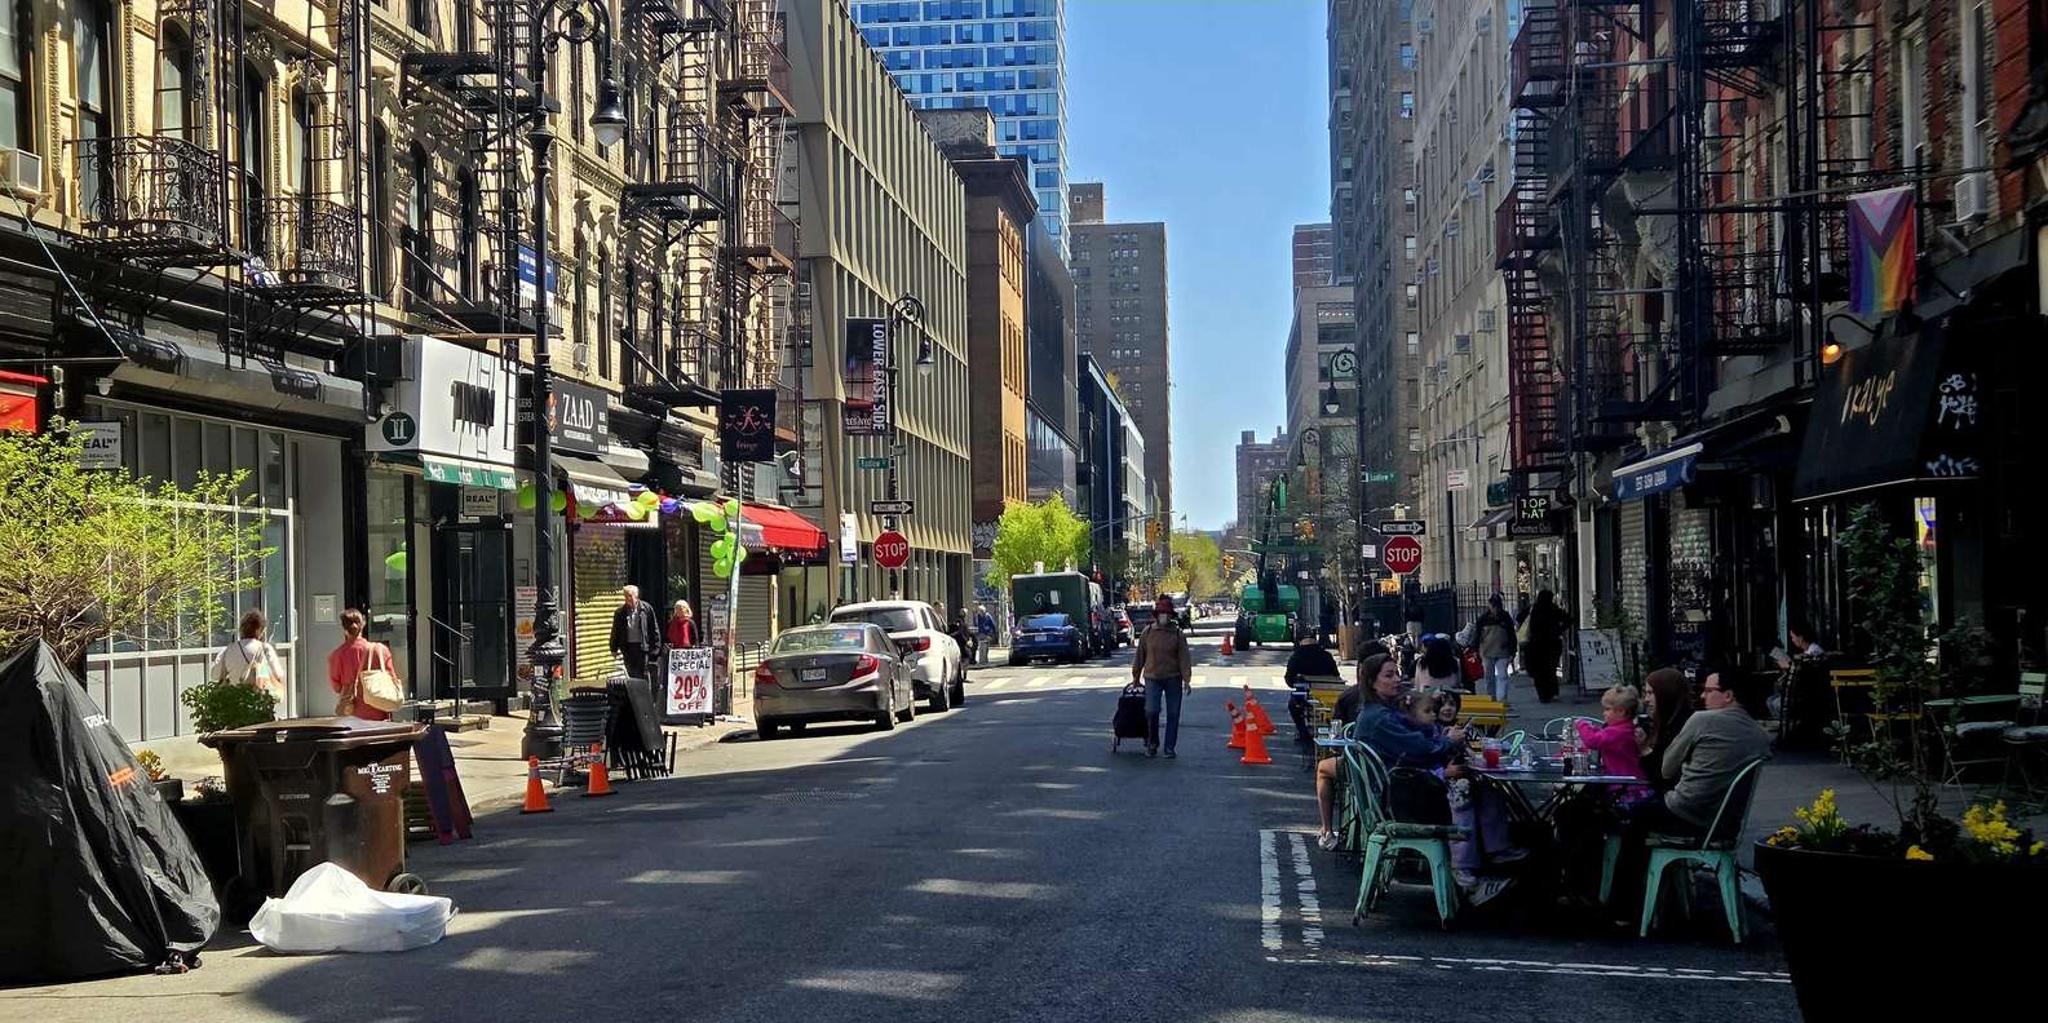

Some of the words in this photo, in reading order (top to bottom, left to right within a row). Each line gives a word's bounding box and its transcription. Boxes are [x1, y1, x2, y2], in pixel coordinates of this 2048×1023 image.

[873, 323, 885, 366] LOWER
[873, 370, 885, 401] EAST
[562, 393, 594, 430] ZAAD
[873, 403, 886, 431] SIDE
[1520, 498, 1547, 509] TOP
[875, 543, 906, 558] STOP
[1387, 548, 1420, 562] STOP
[1674, 623, 1700, 634] ZEST
[671, 660, 710, 671] SPECIAL
[674, 675, 707, 700] 20%
[678, 702, 702, 710] OFF
